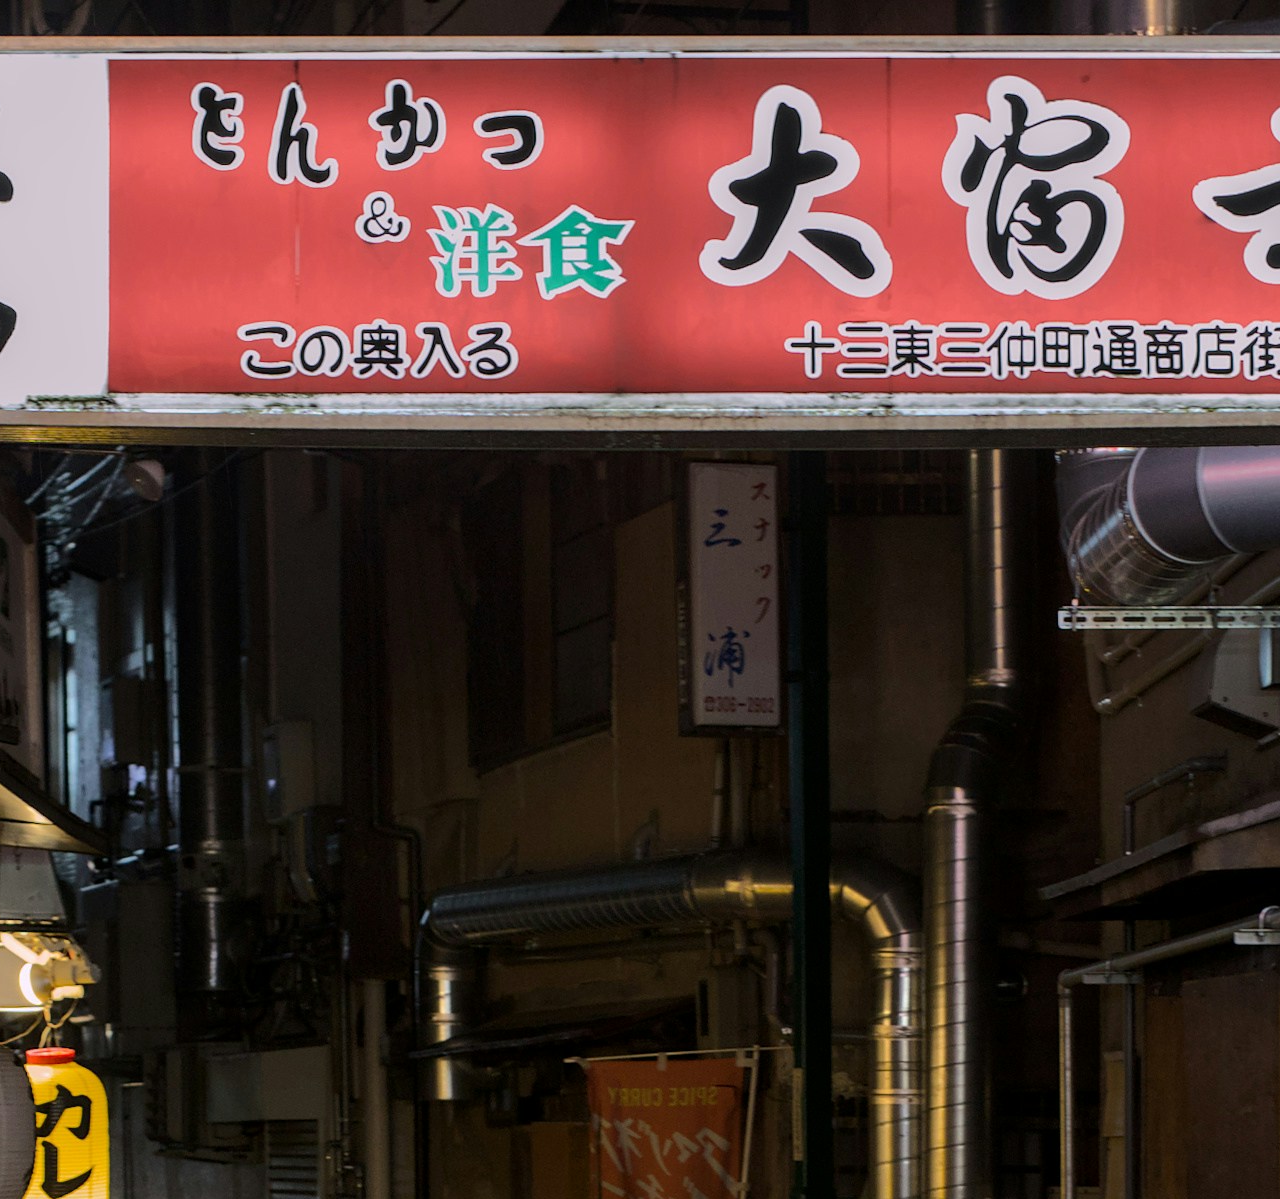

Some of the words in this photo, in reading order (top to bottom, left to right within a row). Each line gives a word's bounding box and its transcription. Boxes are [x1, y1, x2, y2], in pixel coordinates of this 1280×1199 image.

[196, 82, 540, 184] とんかつ
[362, 195, 407, 241] &
[433, 208, 631, 295] 洋食
[245, 325, 517, 377] この奥入る
[750, 481, 772, 625] スナック
